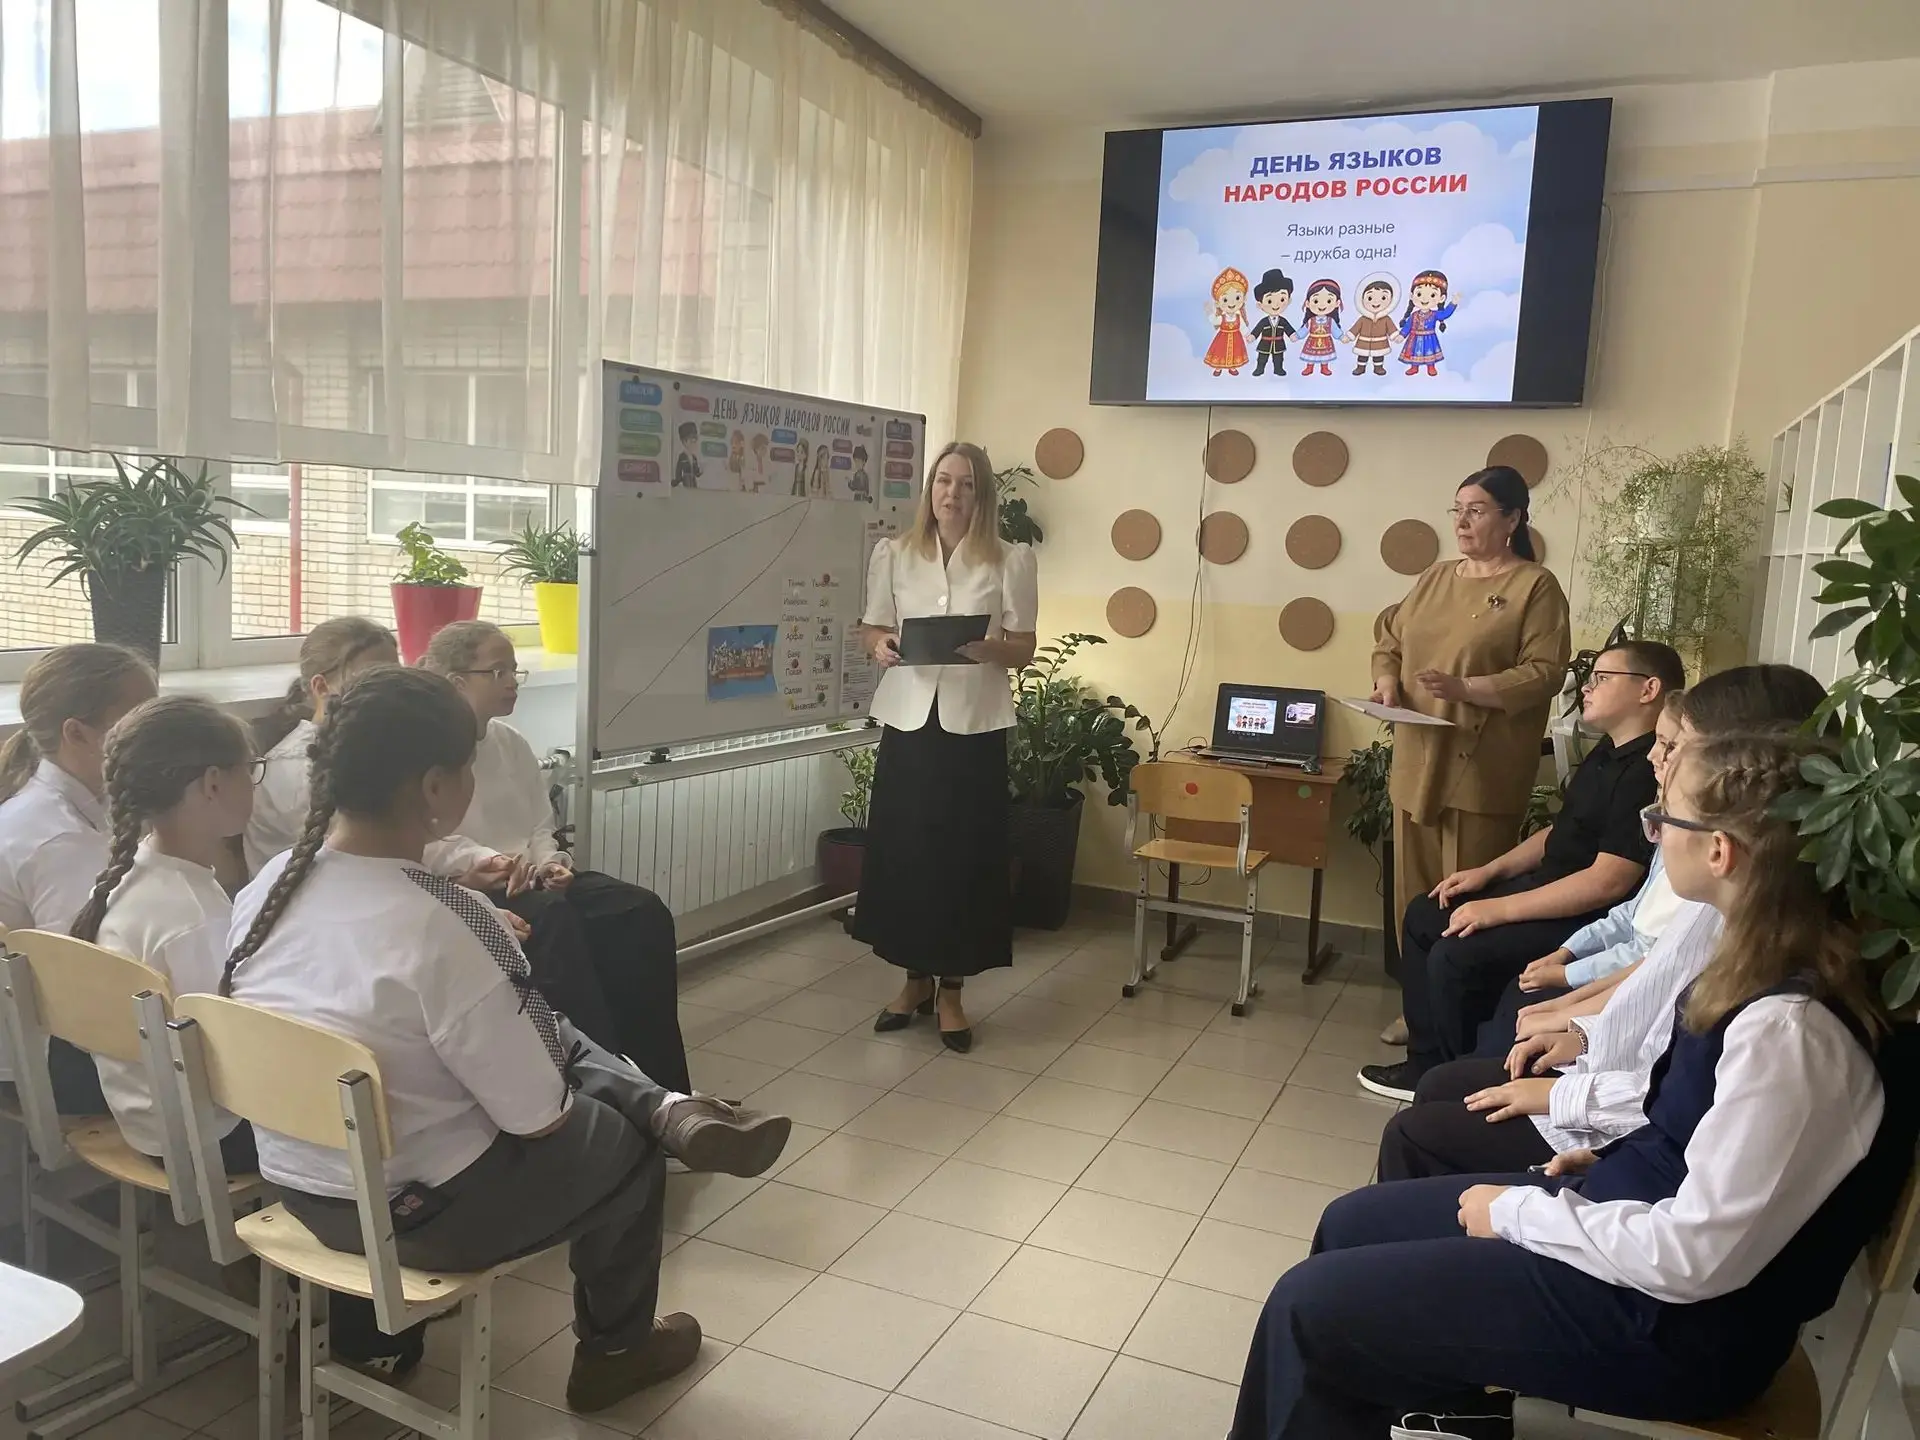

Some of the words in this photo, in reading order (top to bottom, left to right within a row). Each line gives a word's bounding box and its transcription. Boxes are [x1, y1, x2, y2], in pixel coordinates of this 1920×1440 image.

[1250, 154, 1320, 178] ДЕНЬ
[1328, 147, 1441, 170] ЯЗЫКОВ
[1224, 180, 1347, 203] НАРОДОВ
[1356, 174, 1468, 197] РОССИИ
[1287, 223, 1334, 237] Языки
[1338, 222, 1395, 239] разные
[1294, 246, 1350, 263] дружба
[1355, 244, 1397, 261] одна!
[712, 398, 738, 420] ДЕНЬ
[740, 402, 780, 429] ЯЗЫКОВ
[784, 408, 821, 433] НАРОДОВ
[823, 415, 851, 437] РОССИИ
